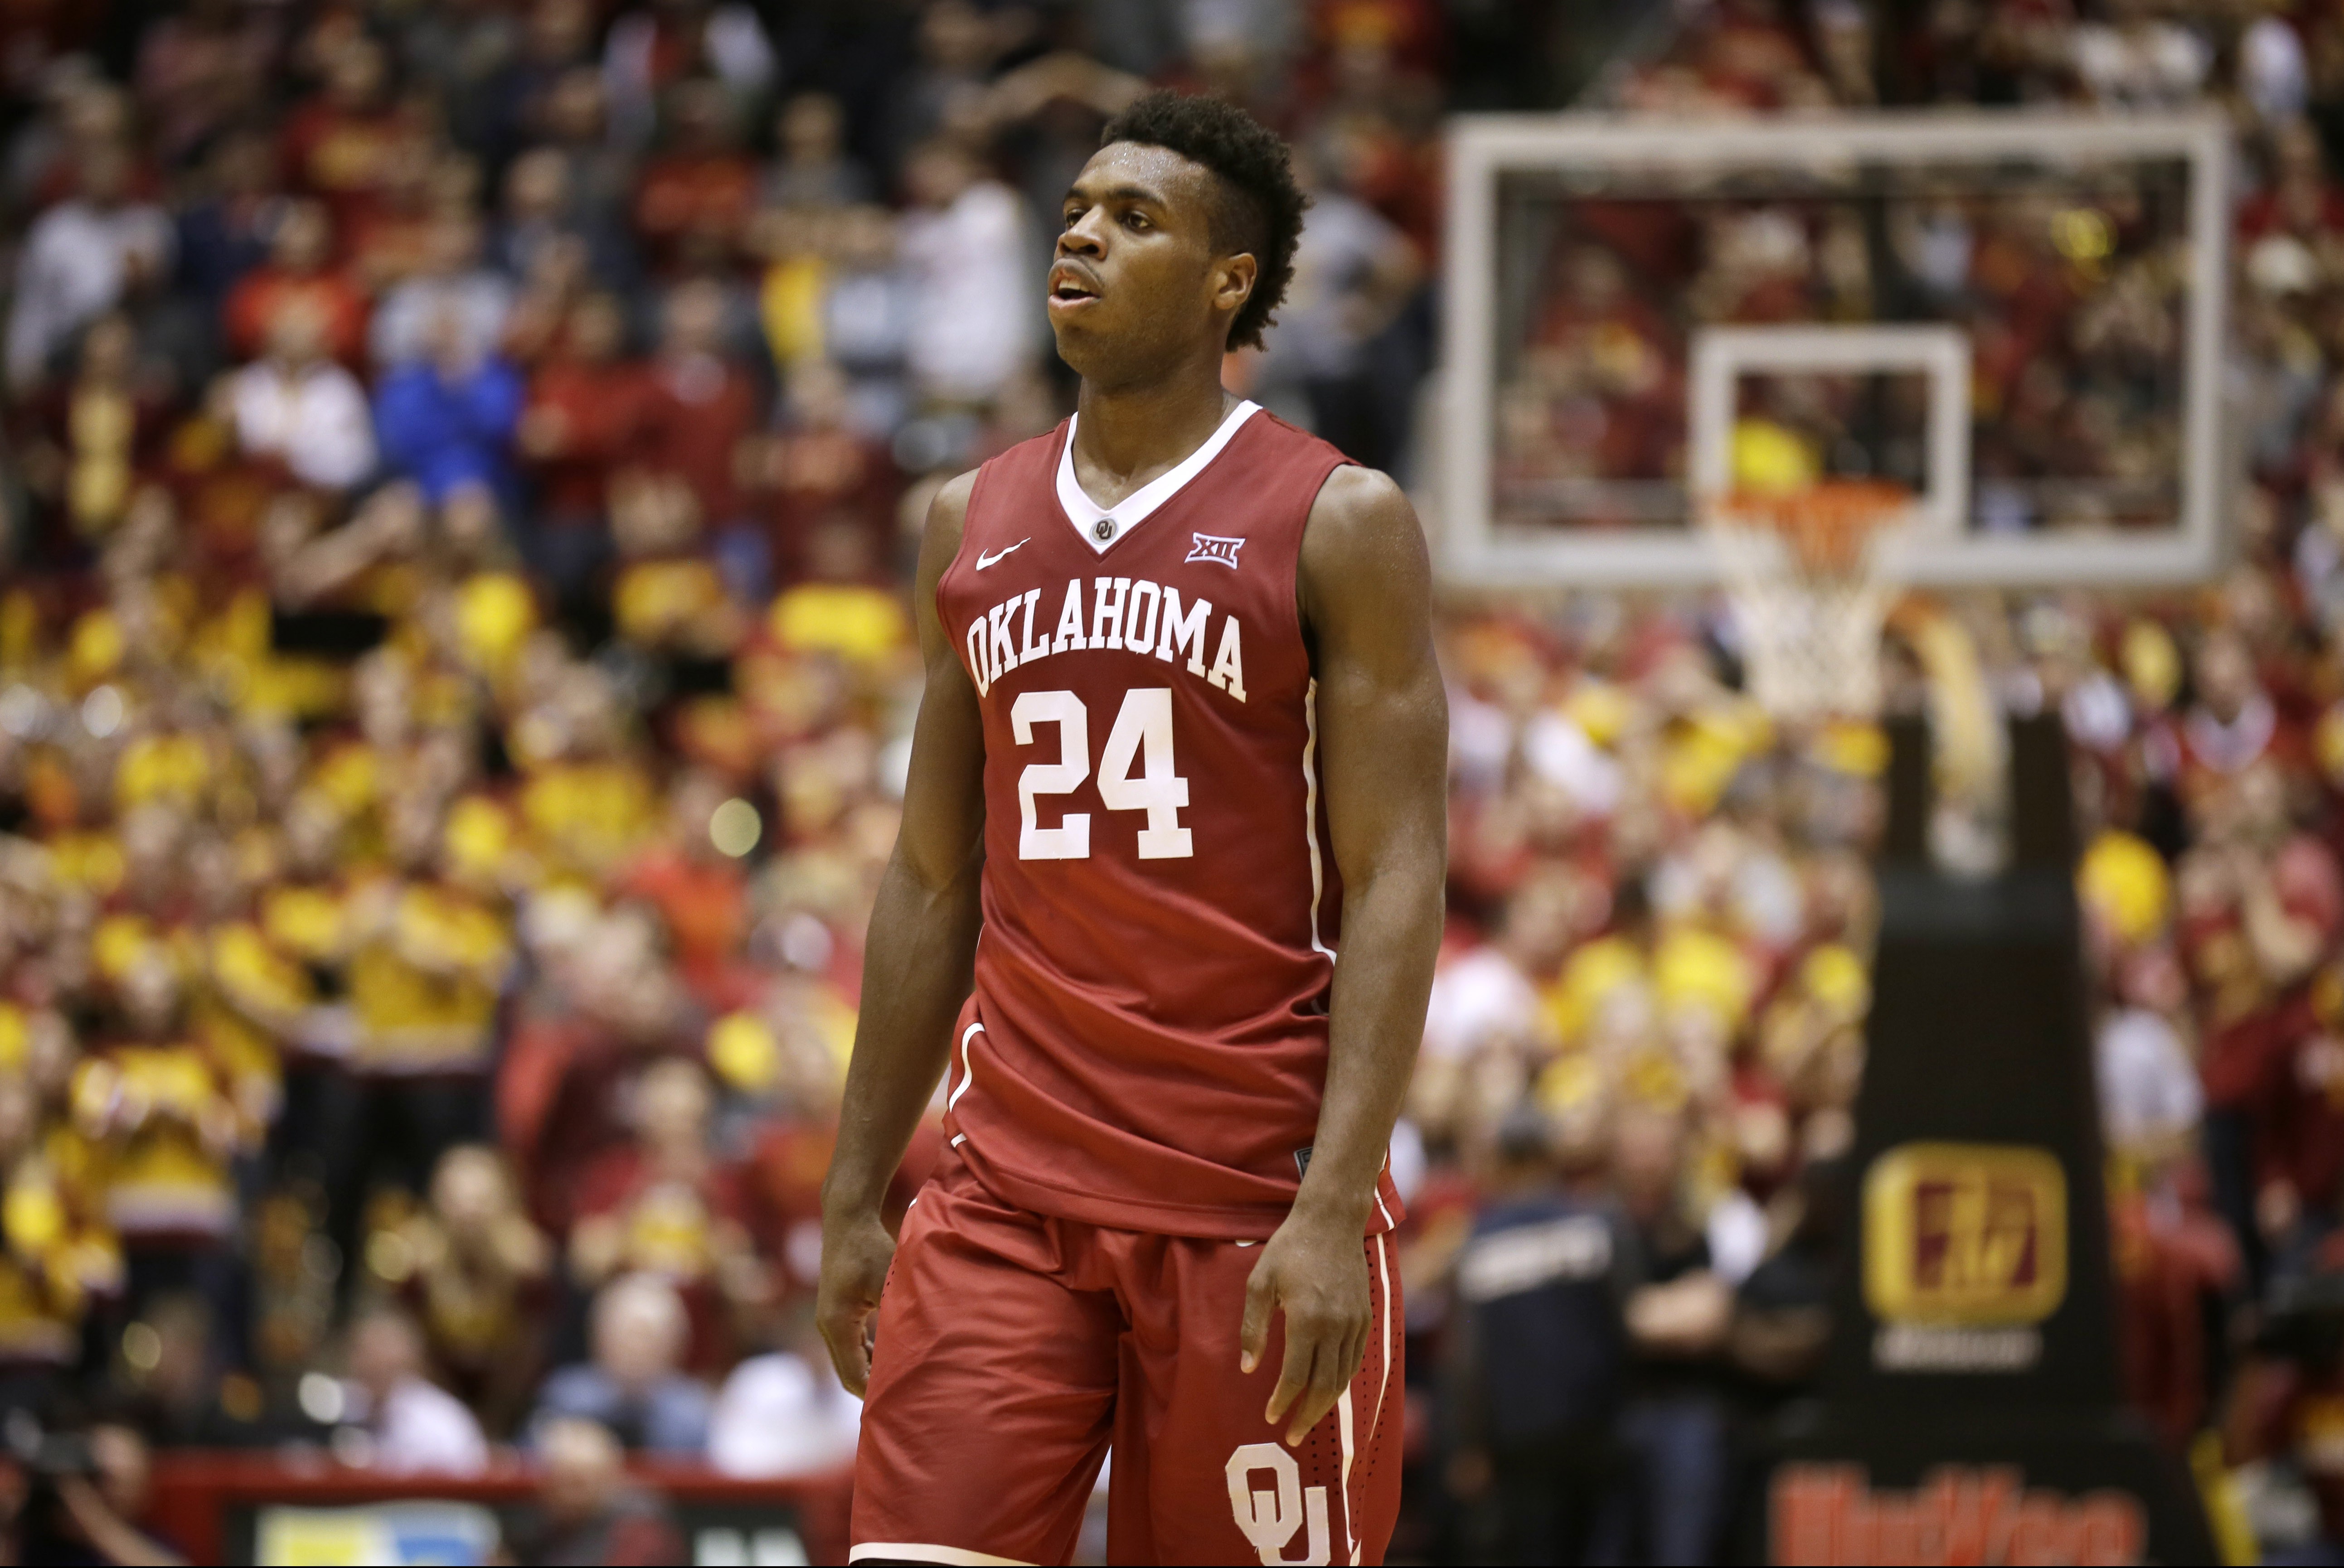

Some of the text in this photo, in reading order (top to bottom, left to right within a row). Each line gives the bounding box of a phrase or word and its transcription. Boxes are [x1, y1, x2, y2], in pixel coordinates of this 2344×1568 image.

[1096, 521, 1113, 540] OU
[1189, 536, 1241, 565] XII
[967, 577, 1247, 703] OKLAHOMA
[1011, 687, 1194, 860] 24
[1225, 1442, 1331, 1566] OU
